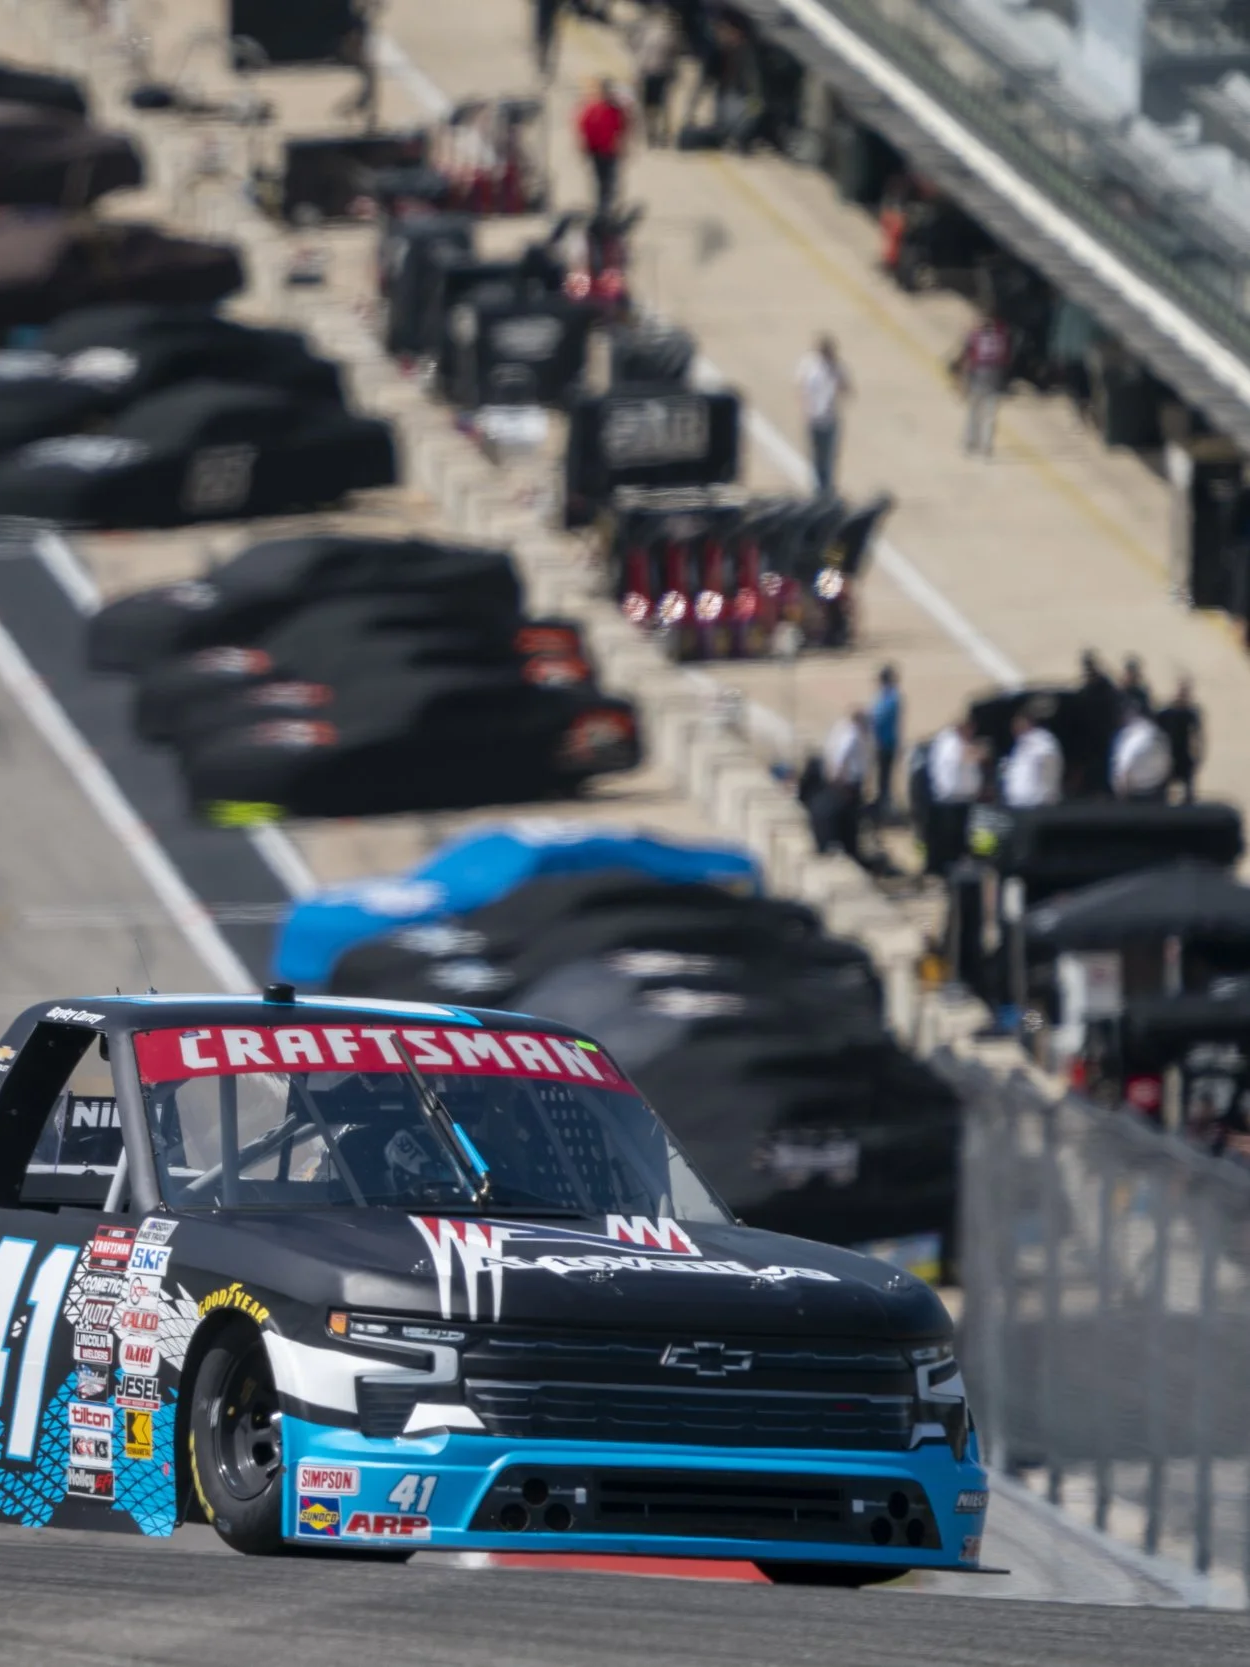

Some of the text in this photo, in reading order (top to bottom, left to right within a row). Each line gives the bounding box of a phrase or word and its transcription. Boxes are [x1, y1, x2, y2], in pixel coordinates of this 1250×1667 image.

[180, 1026, 603, 1081] CRAFTSMAN
[93, 1240, 130, 1256] CRAFTSMAN
[131, 1247, 168, 1270] SKF
[83, 1275, 124, 1294] COMETIC
[82, 1302, 113, 1325] KLOTZ
[198, 1281, 271, 1325] GOODYEAR
[121, 1311, 159, 1331] CALICO
[76, 1333, 108, 1348] LINCOLN
[116, 1375, 161, 1401] JESEL
[71, 1405, 111, 1428] tilton
[68, 1466, 96, 1493] Holley
[301, 1469, 352, 1490] SIMPSON
[388, 1474, 438, 1513] 41
[300, 1510, 338, 1524] SUNOCO
[346, 1514, 429, 1535] ARP
